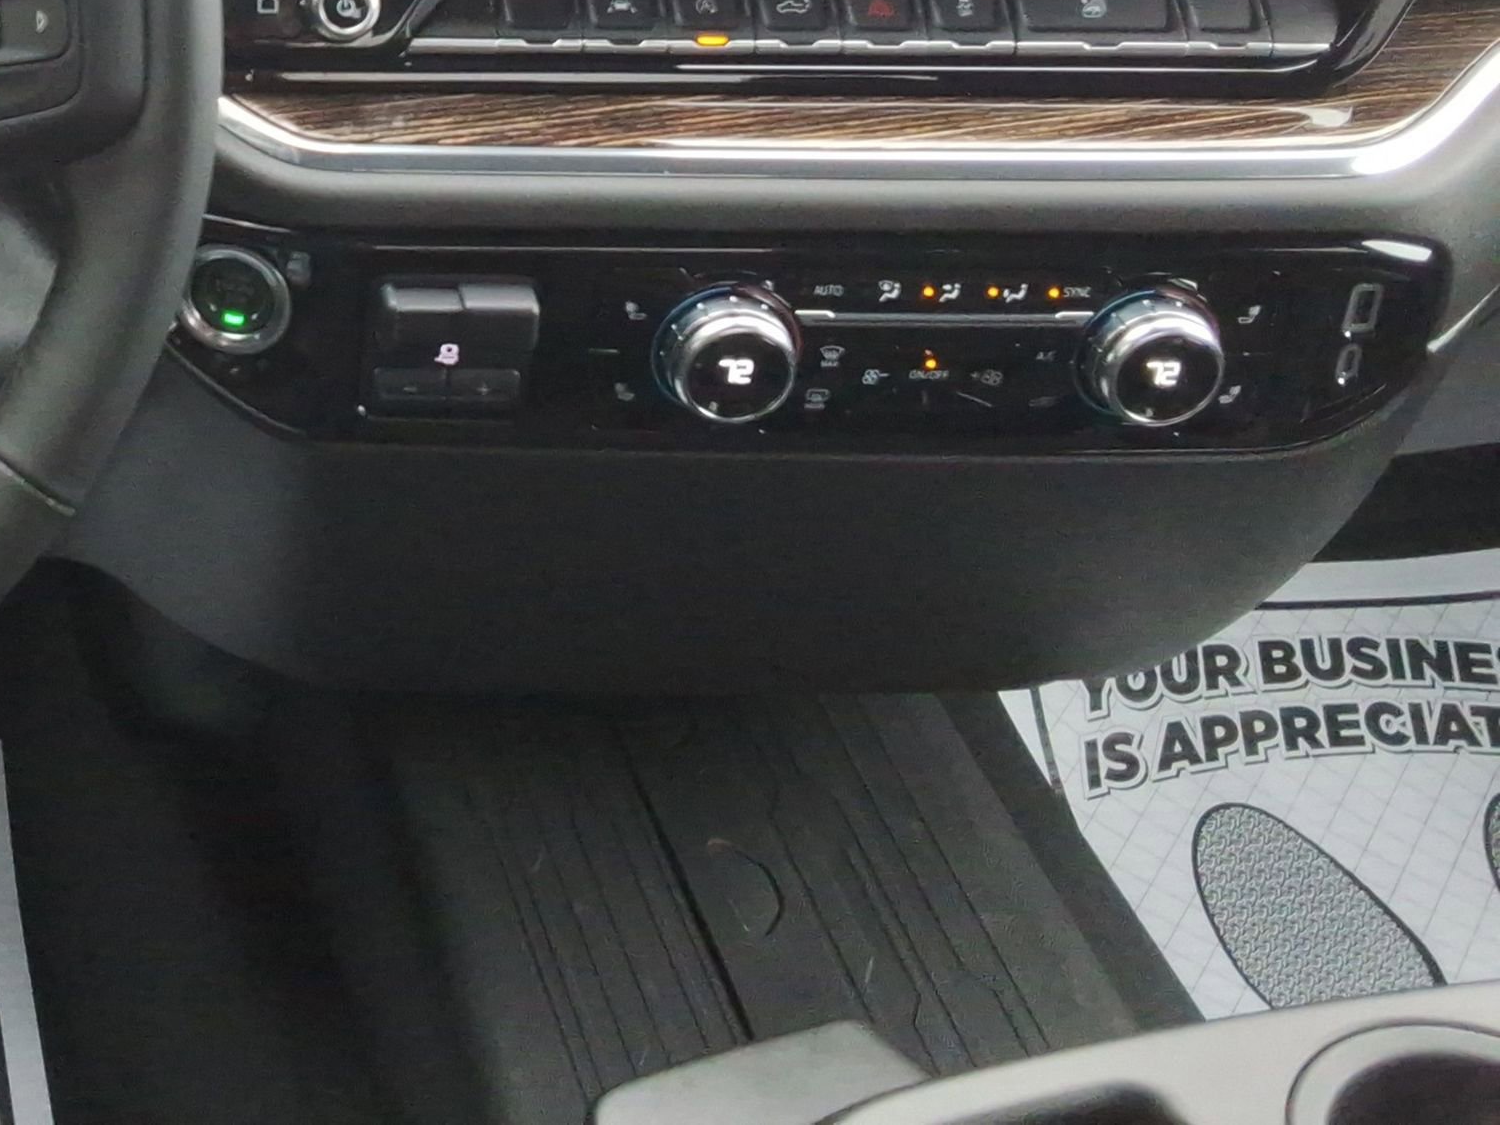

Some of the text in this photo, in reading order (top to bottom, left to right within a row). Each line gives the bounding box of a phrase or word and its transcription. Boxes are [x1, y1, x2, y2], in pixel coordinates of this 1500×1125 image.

[814, 285, 844, 297] AUTO
[1062, 286, 1092, 298] SYNC
[1146, 361, 1182, 388] 72
[1257, 636, 1500, 686] BUSINE
[1084, 732, 1141, 791] IS
